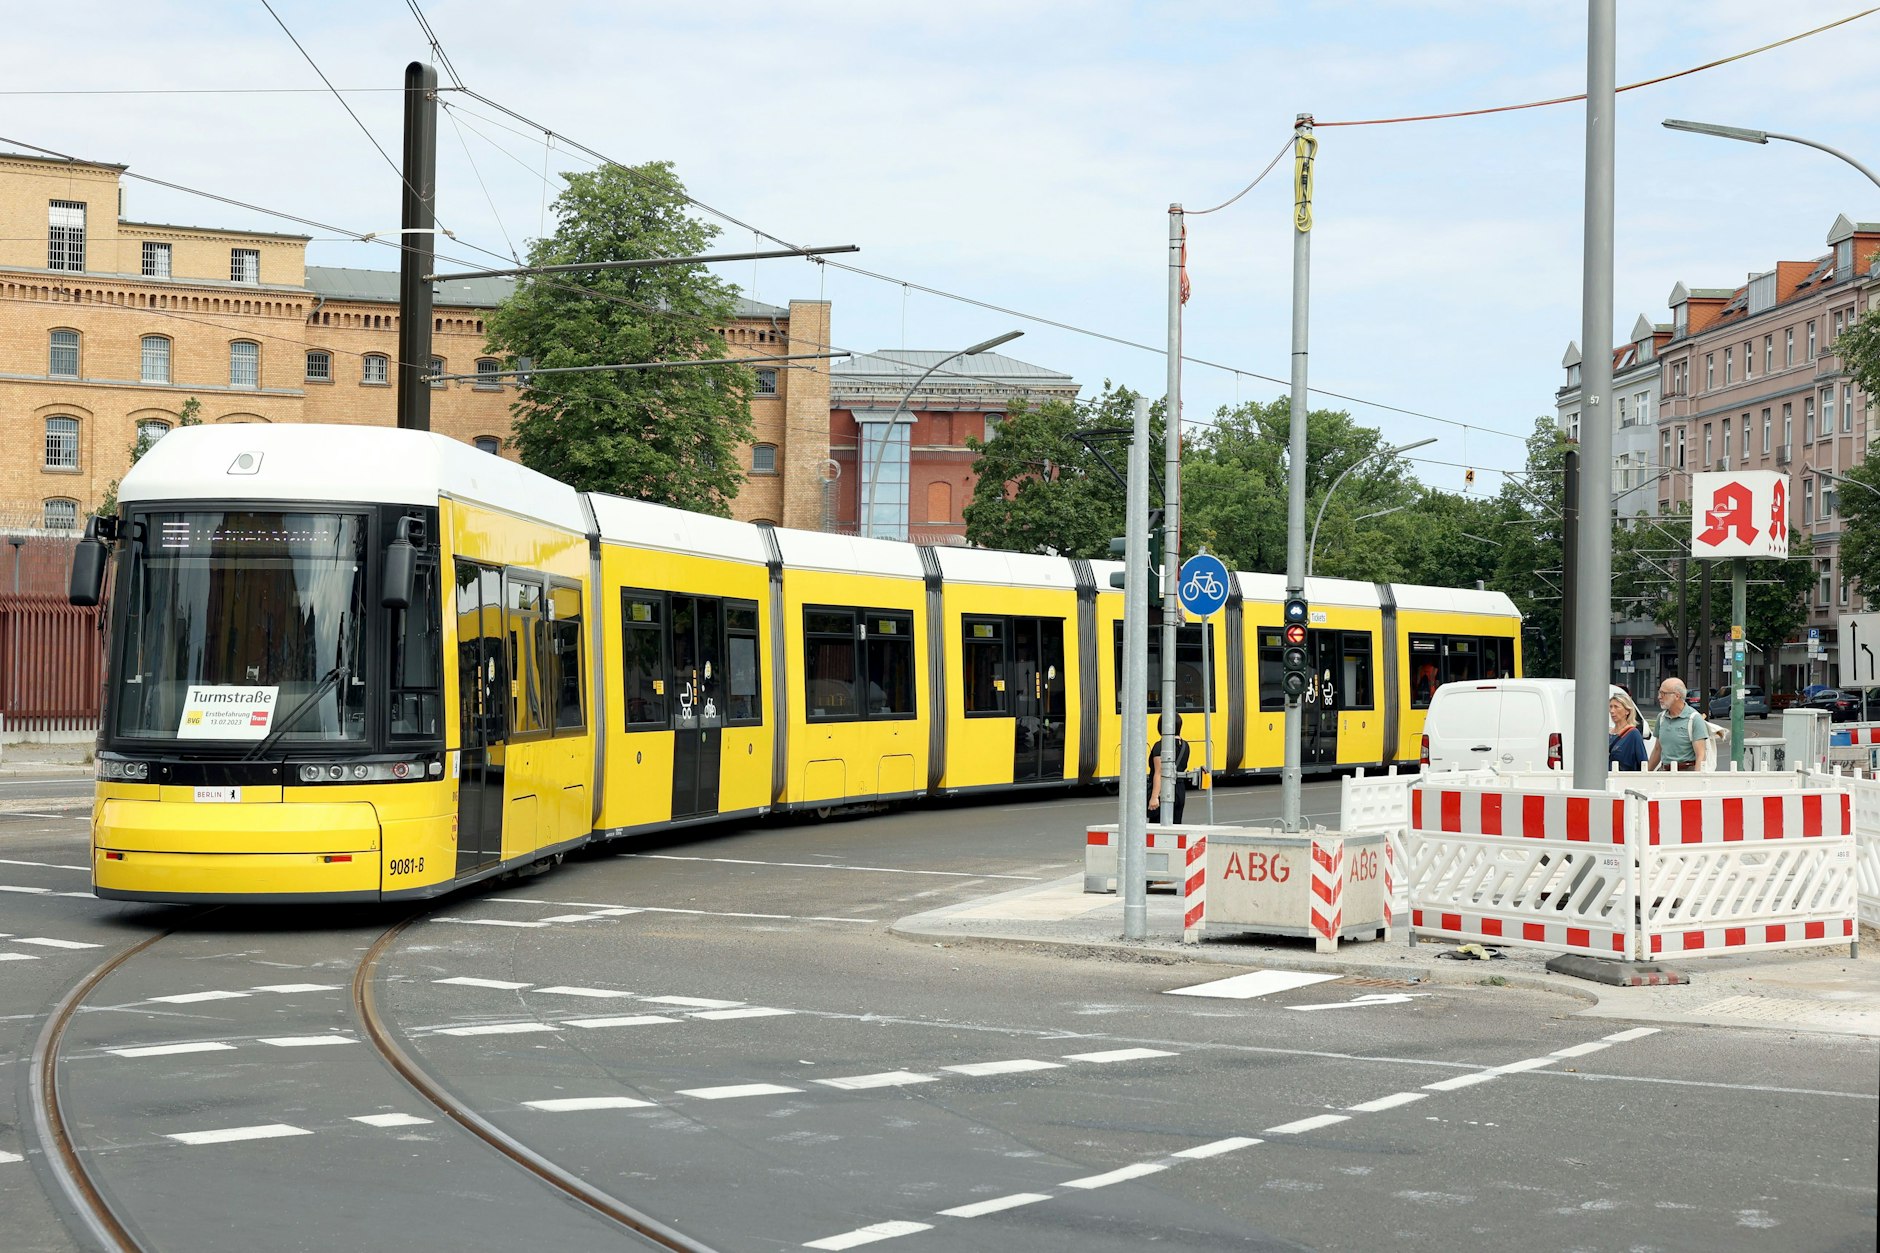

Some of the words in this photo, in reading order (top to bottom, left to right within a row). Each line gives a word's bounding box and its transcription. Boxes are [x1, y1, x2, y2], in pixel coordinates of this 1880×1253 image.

[193, 690, 272, 703] Turmstraße
[390, 857, 424, 875] 9081-B
[1223, 851, 1290, 883] ABG
[1350, 850, 1377, 883] ABG
